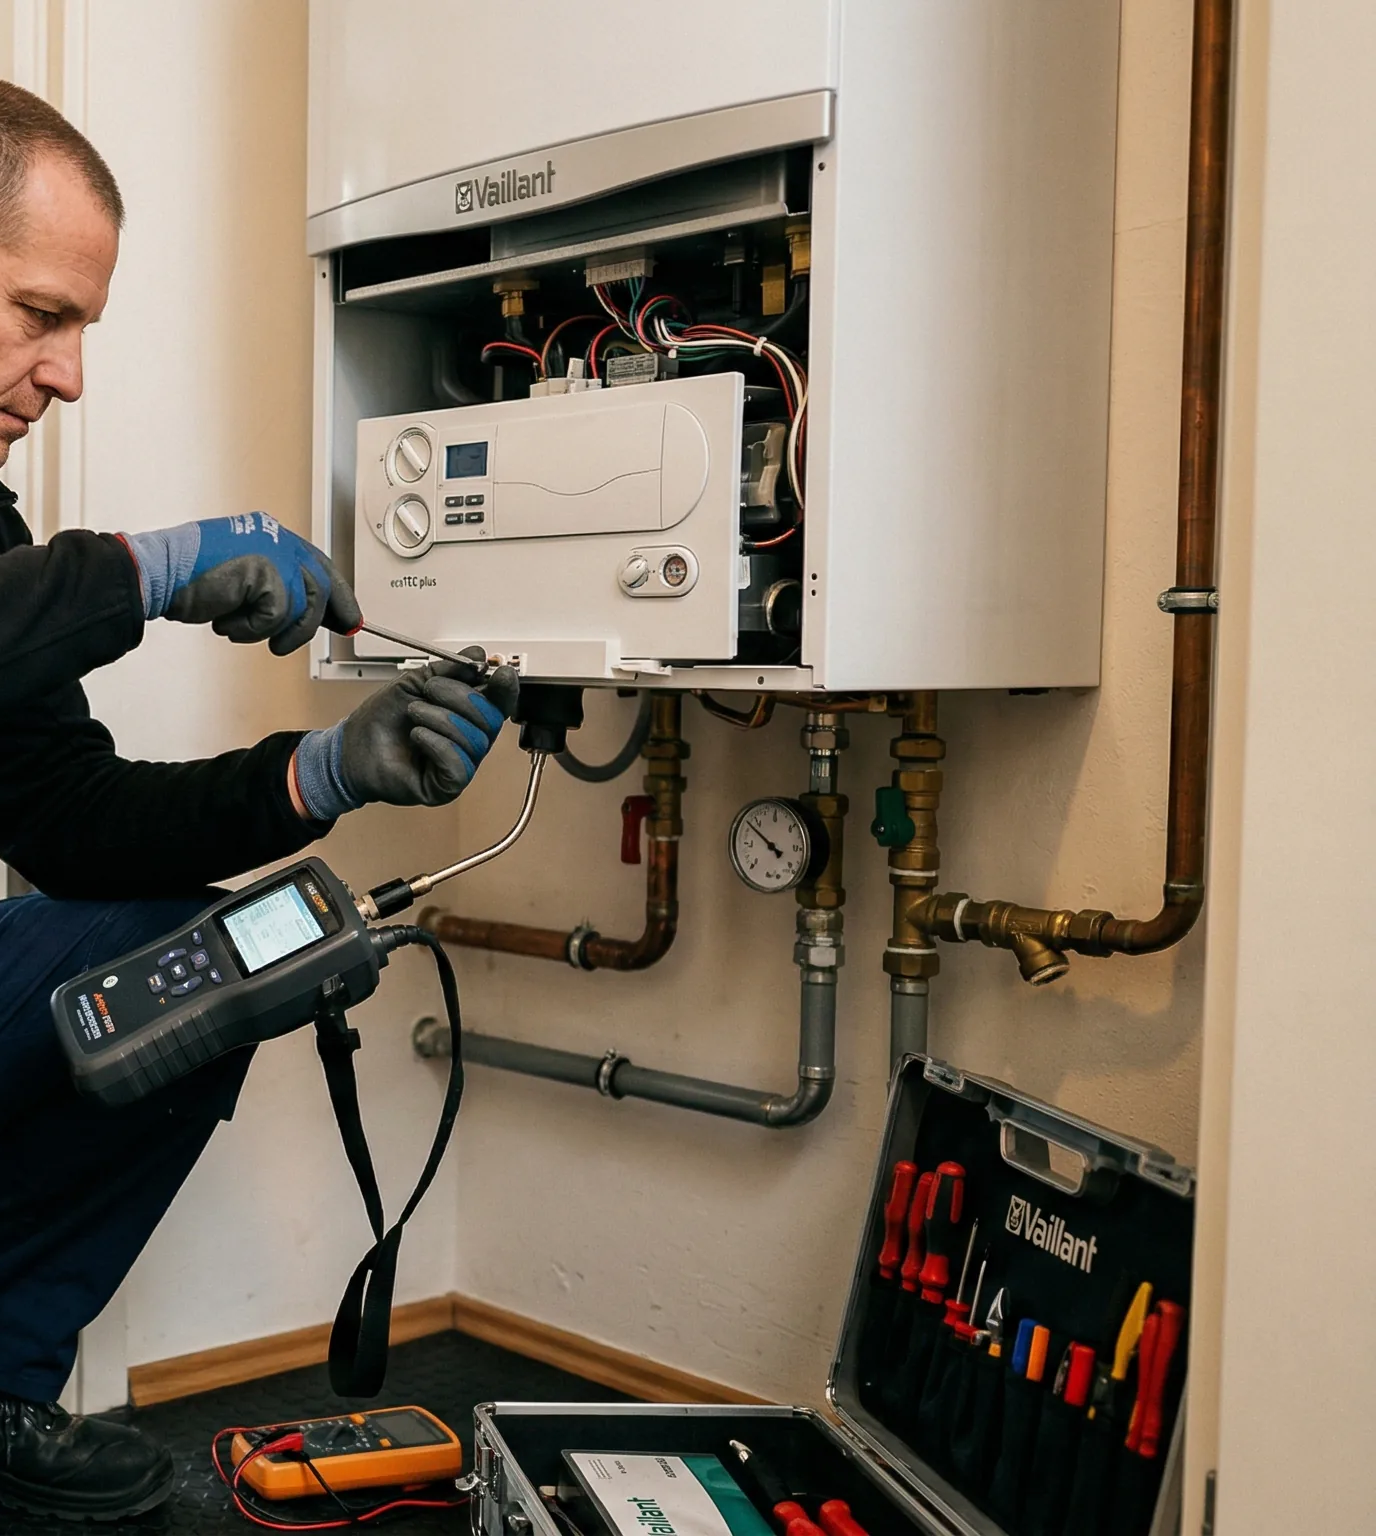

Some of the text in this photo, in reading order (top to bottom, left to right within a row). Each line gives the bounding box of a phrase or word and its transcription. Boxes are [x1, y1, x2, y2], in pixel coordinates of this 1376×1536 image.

[474, 160, 556, 209] Vaillant
[419, 576, 437, 590] plus
[1025, 1202, 1098, 1274] Vaillant
